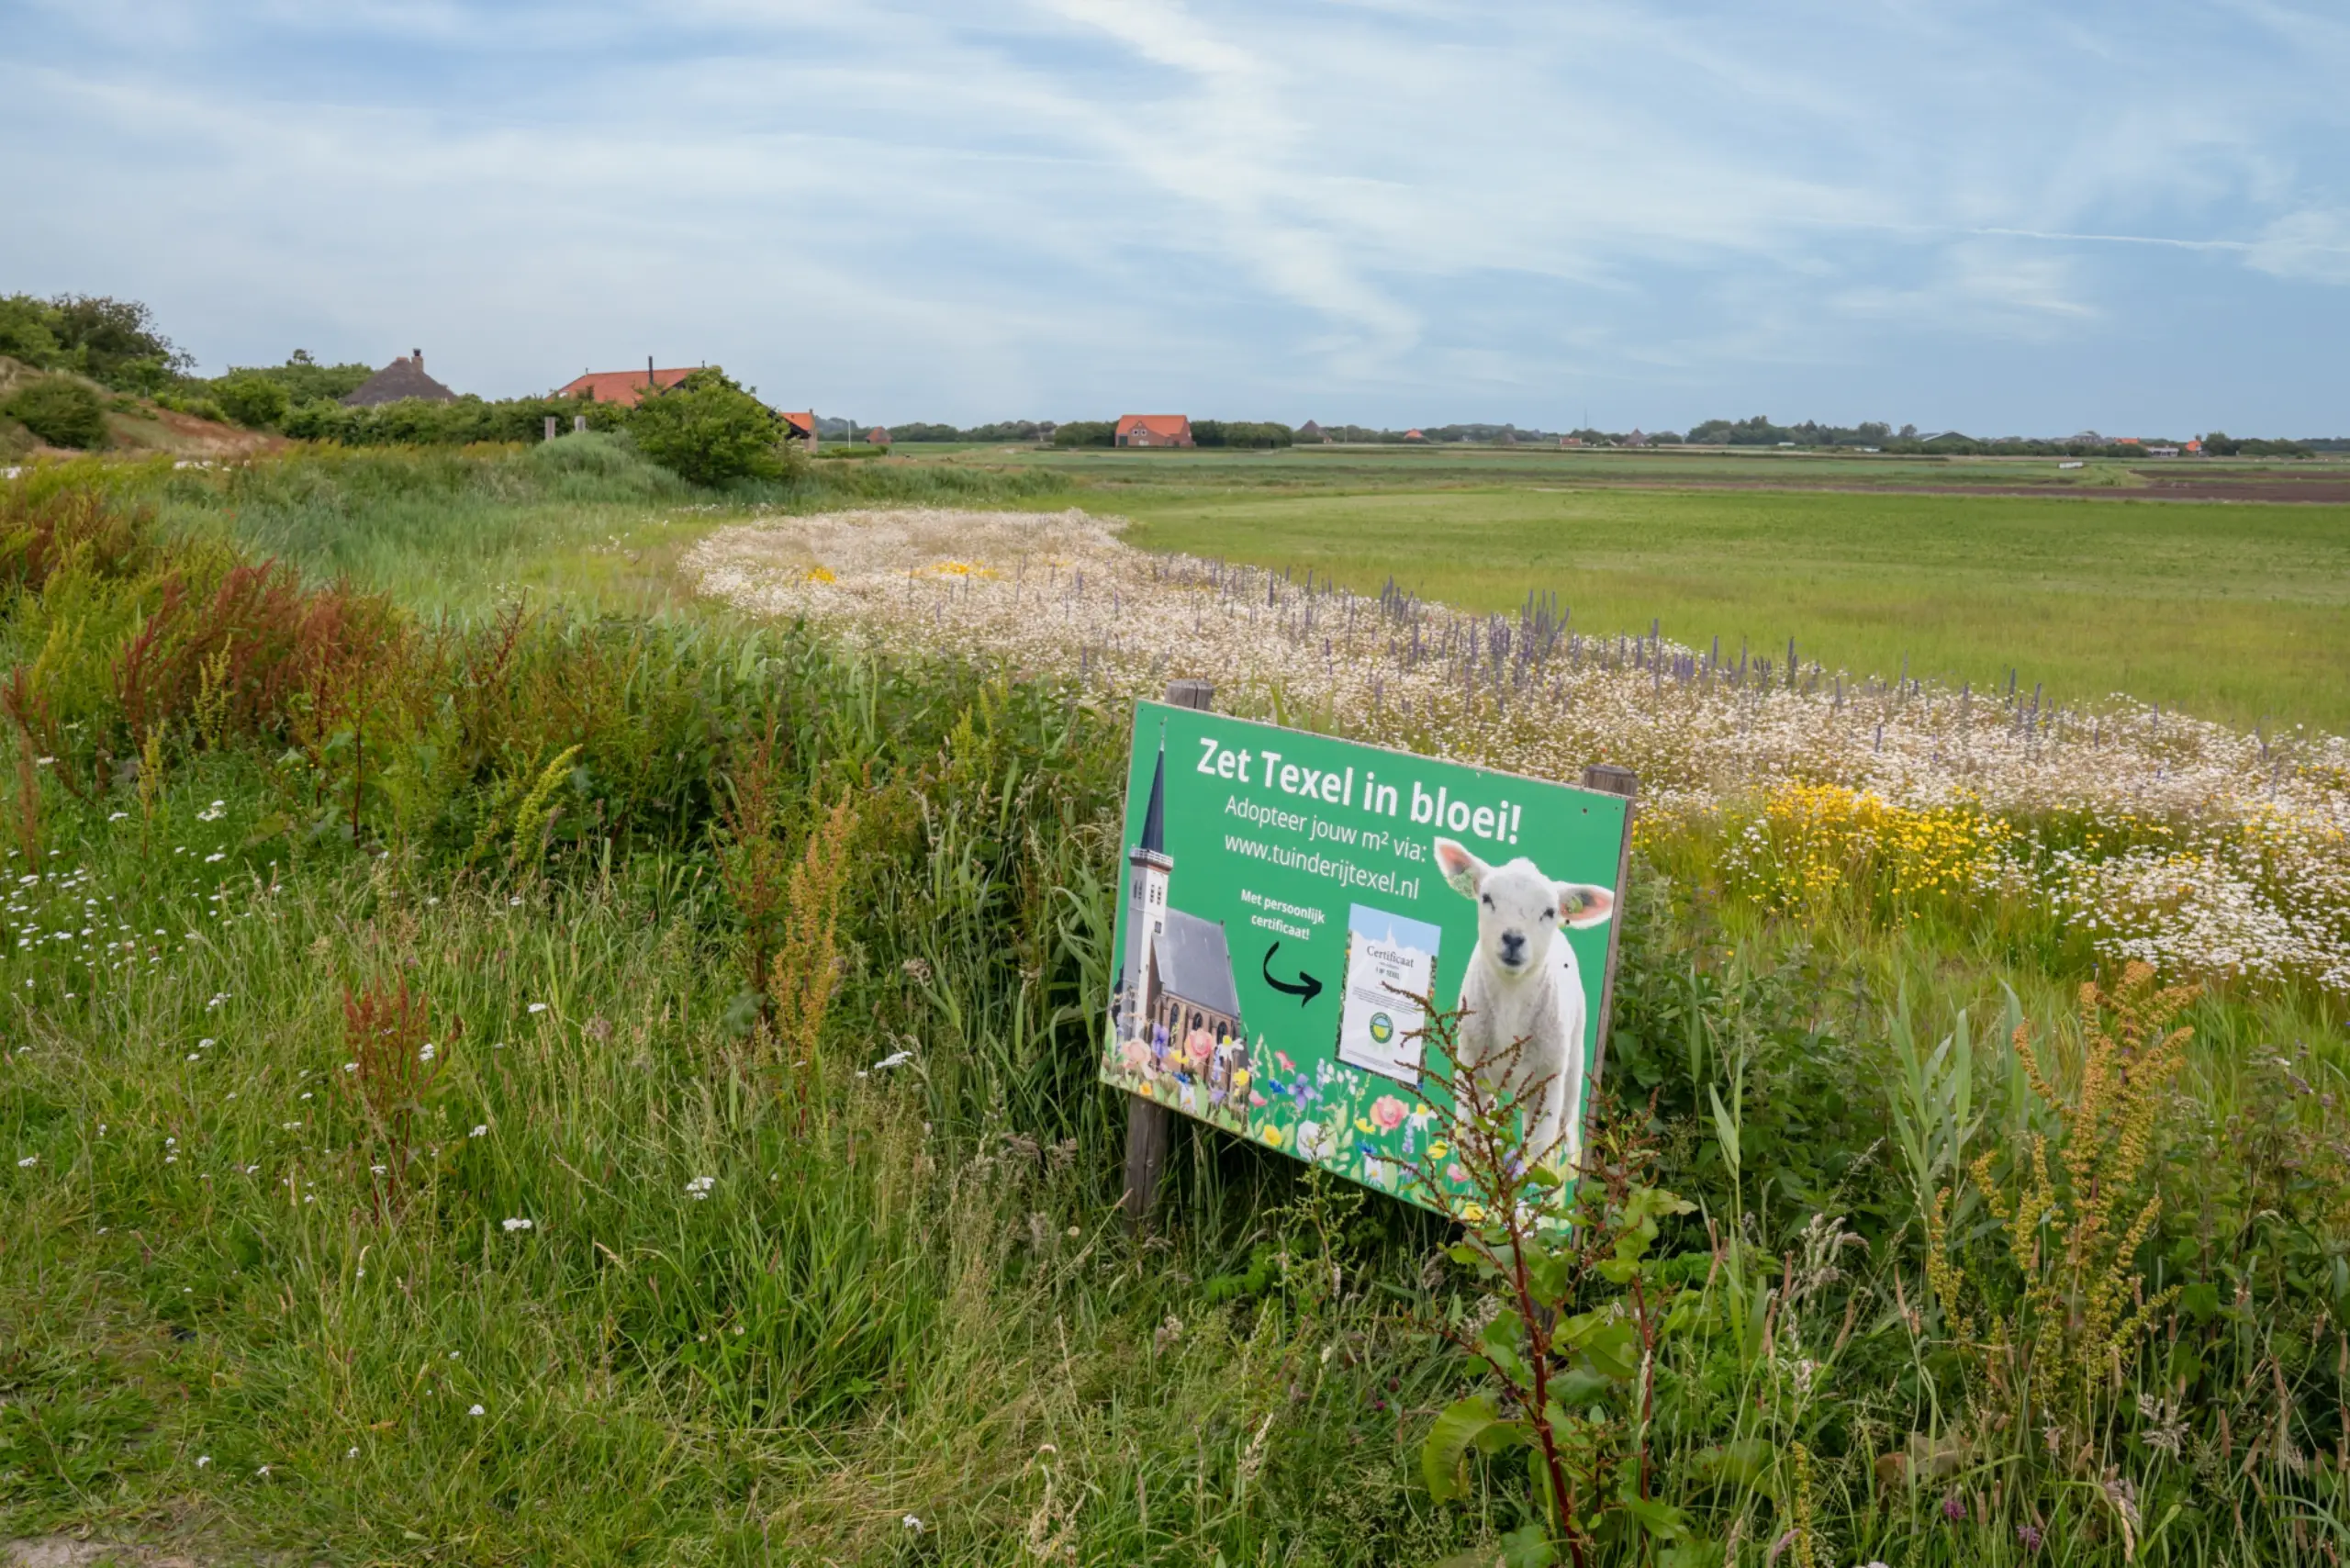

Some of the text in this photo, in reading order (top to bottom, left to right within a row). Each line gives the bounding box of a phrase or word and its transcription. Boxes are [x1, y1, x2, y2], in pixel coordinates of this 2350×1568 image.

[1197, 737, 1522, 845] Zet Texel in bloei!
[1225, 795, 1427, 862] Adopteer jouw m² via:
[1225, 834, 1420, 899] www.tuinderijtexel.nl
[1241, 889, 1326, 924] Met persoonlijk
[1251, 914, 1310, 940] certificaat!
[1366, 946, 1415, 969] Certificaat
